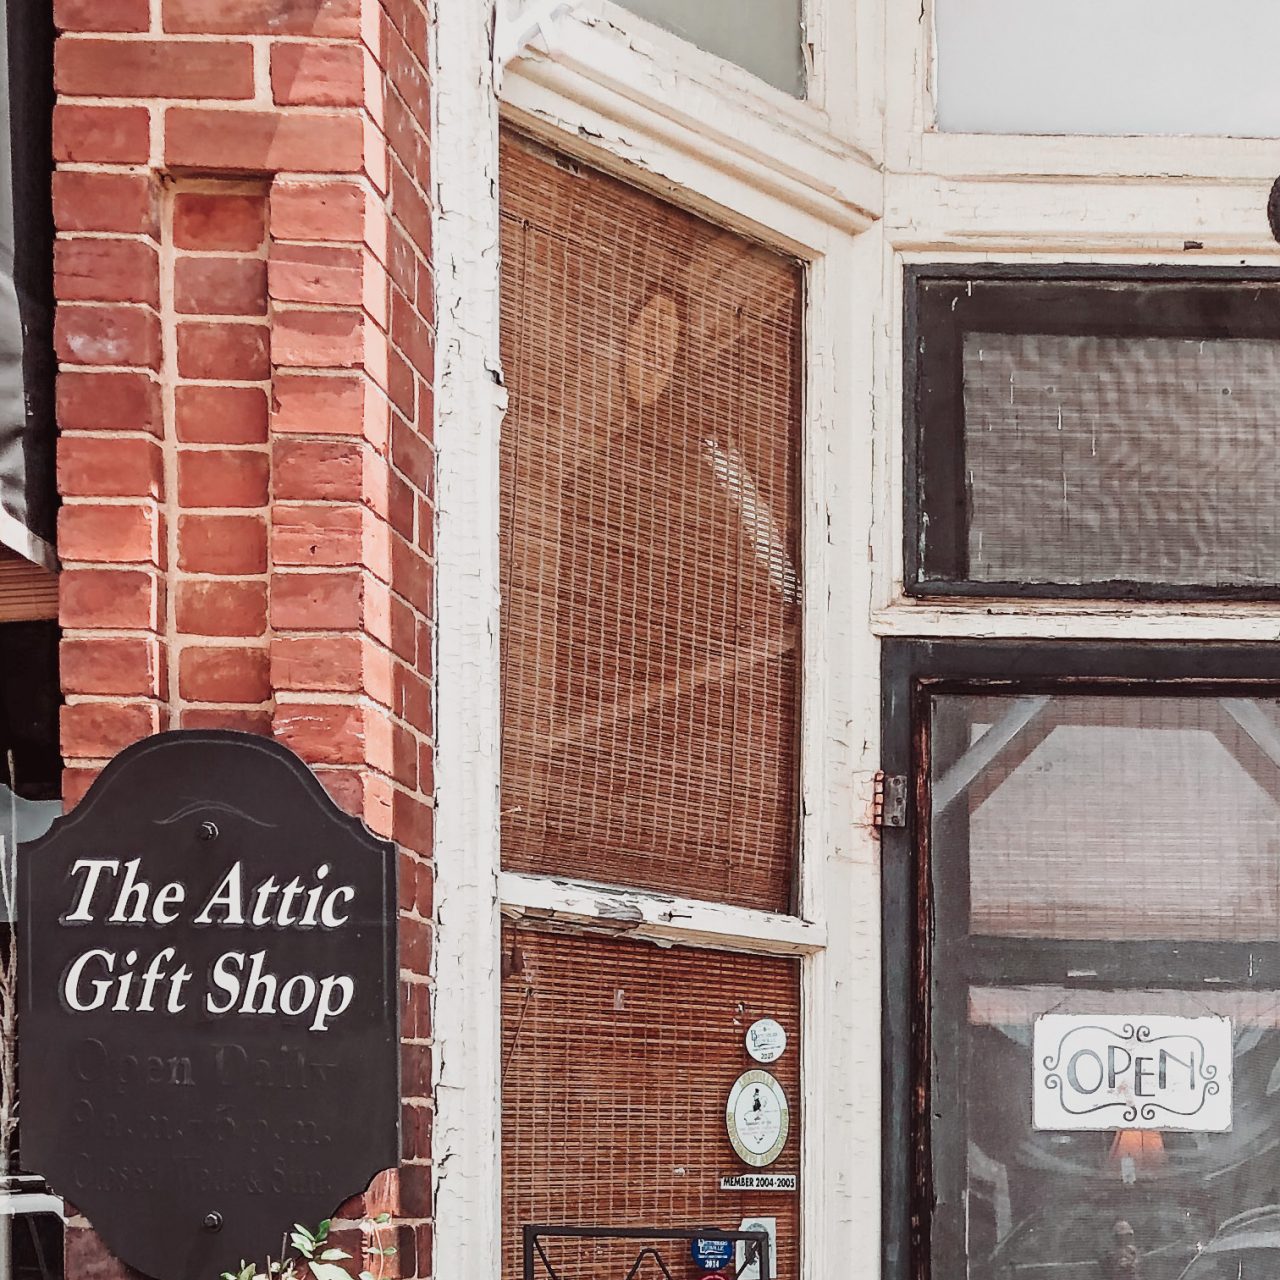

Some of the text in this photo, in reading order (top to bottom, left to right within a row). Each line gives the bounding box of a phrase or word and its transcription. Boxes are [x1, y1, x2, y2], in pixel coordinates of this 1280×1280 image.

[65, 858, 354, 928] The Attic
[64, 947, 354, 1031] Gift Shop
[1066, 1044, 1196, 1098] OPEN
[723, 1176, 754, 1188] MEMBER
